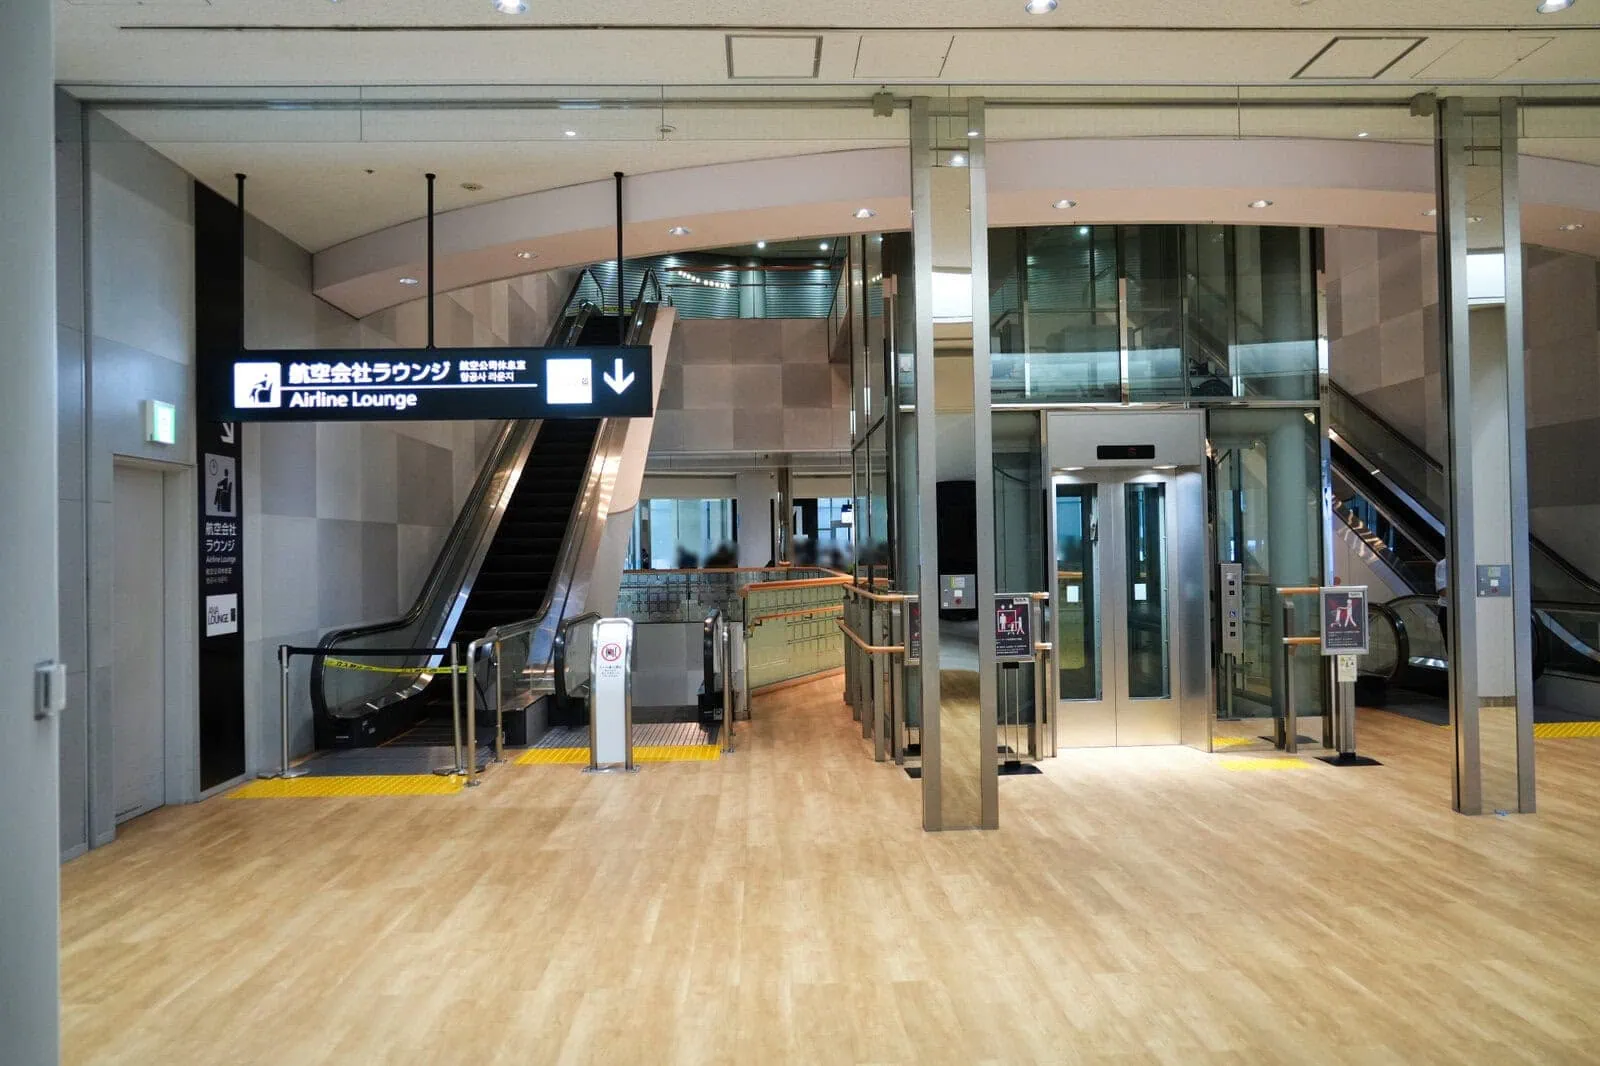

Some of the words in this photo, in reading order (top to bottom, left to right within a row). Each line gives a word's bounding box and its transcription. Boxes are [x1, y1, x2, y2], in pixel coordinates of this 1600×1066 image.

[288, 361, 451, 384] 航空会社ラウンジ
[289, 391, 349, 408] Airline
[352, 391, 418, 410] Lounge
[205, 539, 236, 552] ラウンジ
